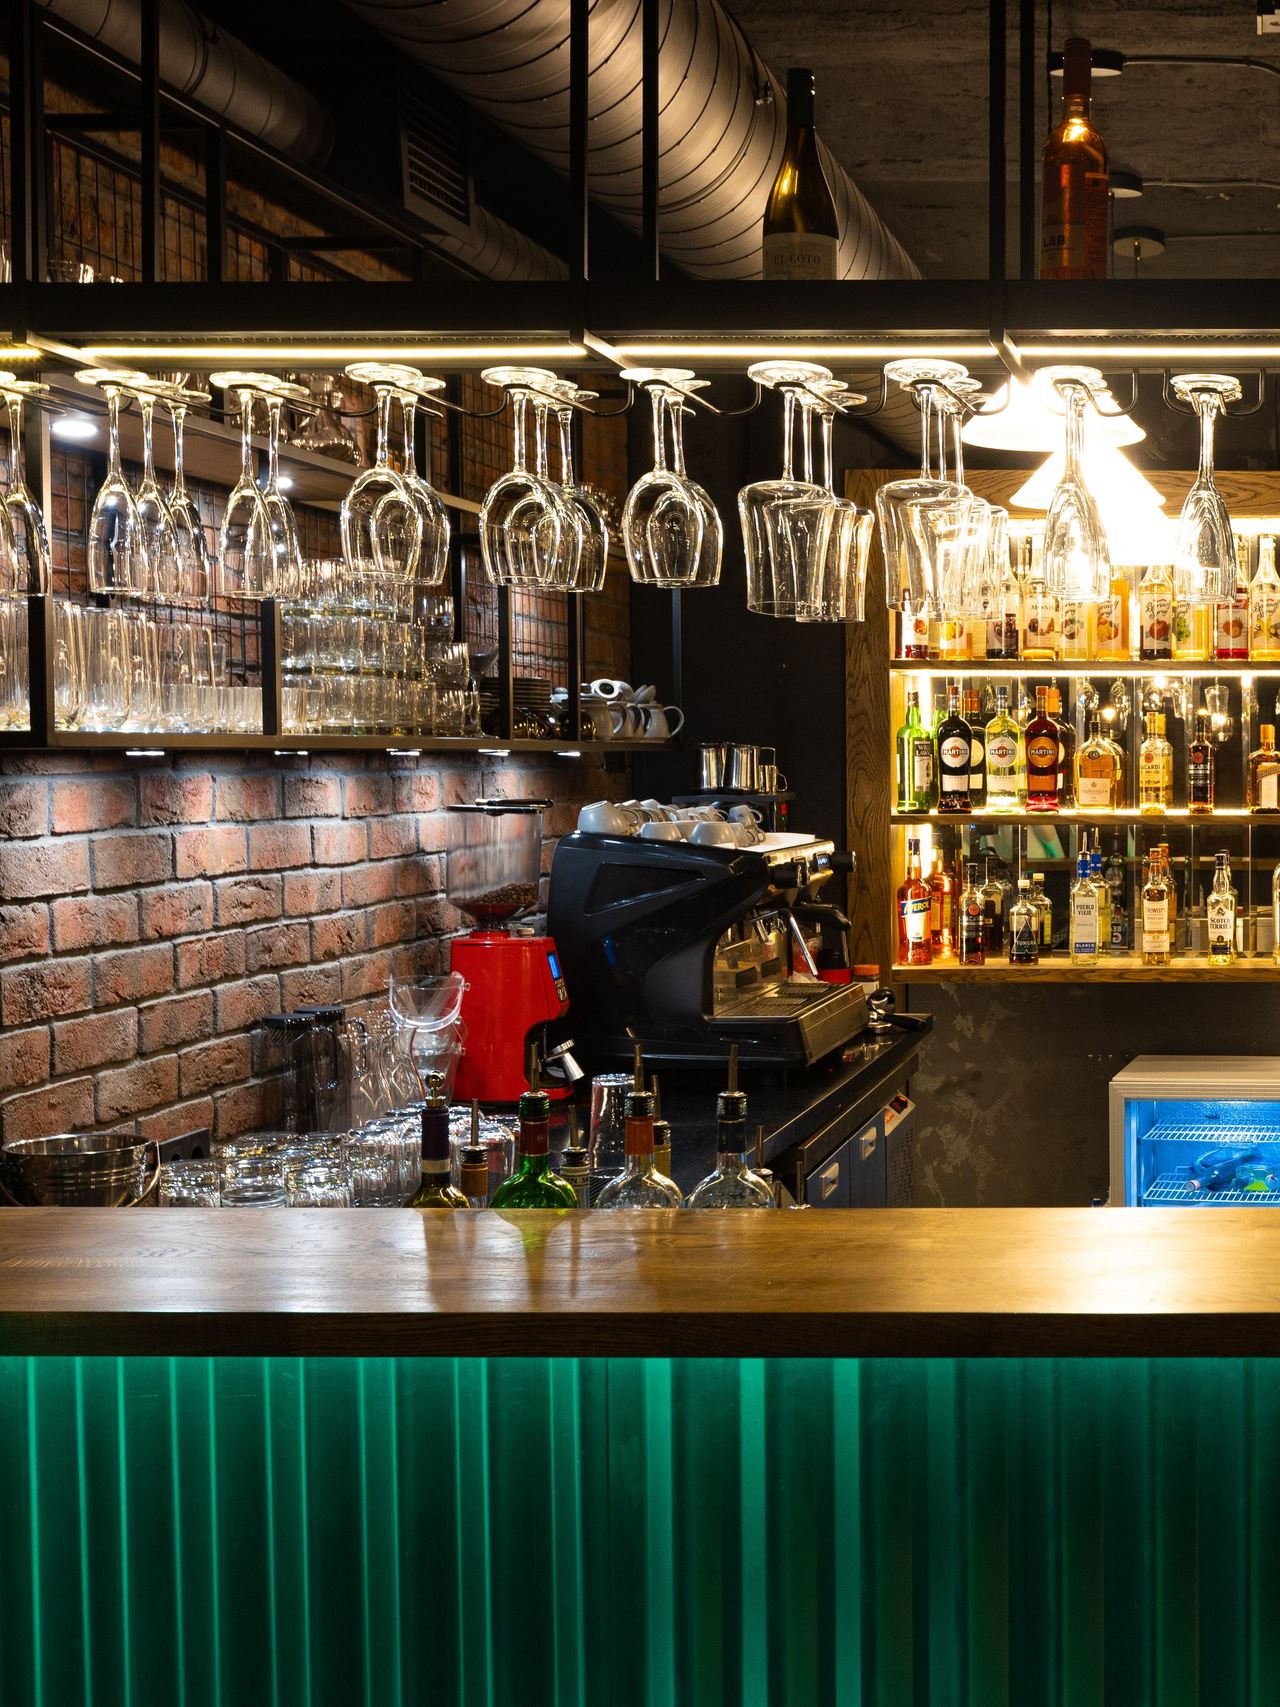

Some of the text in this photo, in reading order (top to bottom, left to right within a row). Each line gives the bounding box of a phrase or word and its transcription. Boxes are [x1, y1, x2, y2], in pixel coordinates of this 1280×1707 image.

[1043, 235, 1065, 247] LAB
[774, 253, 821, 265] EL COTO
[903, 900, 930, 913] APEROL
